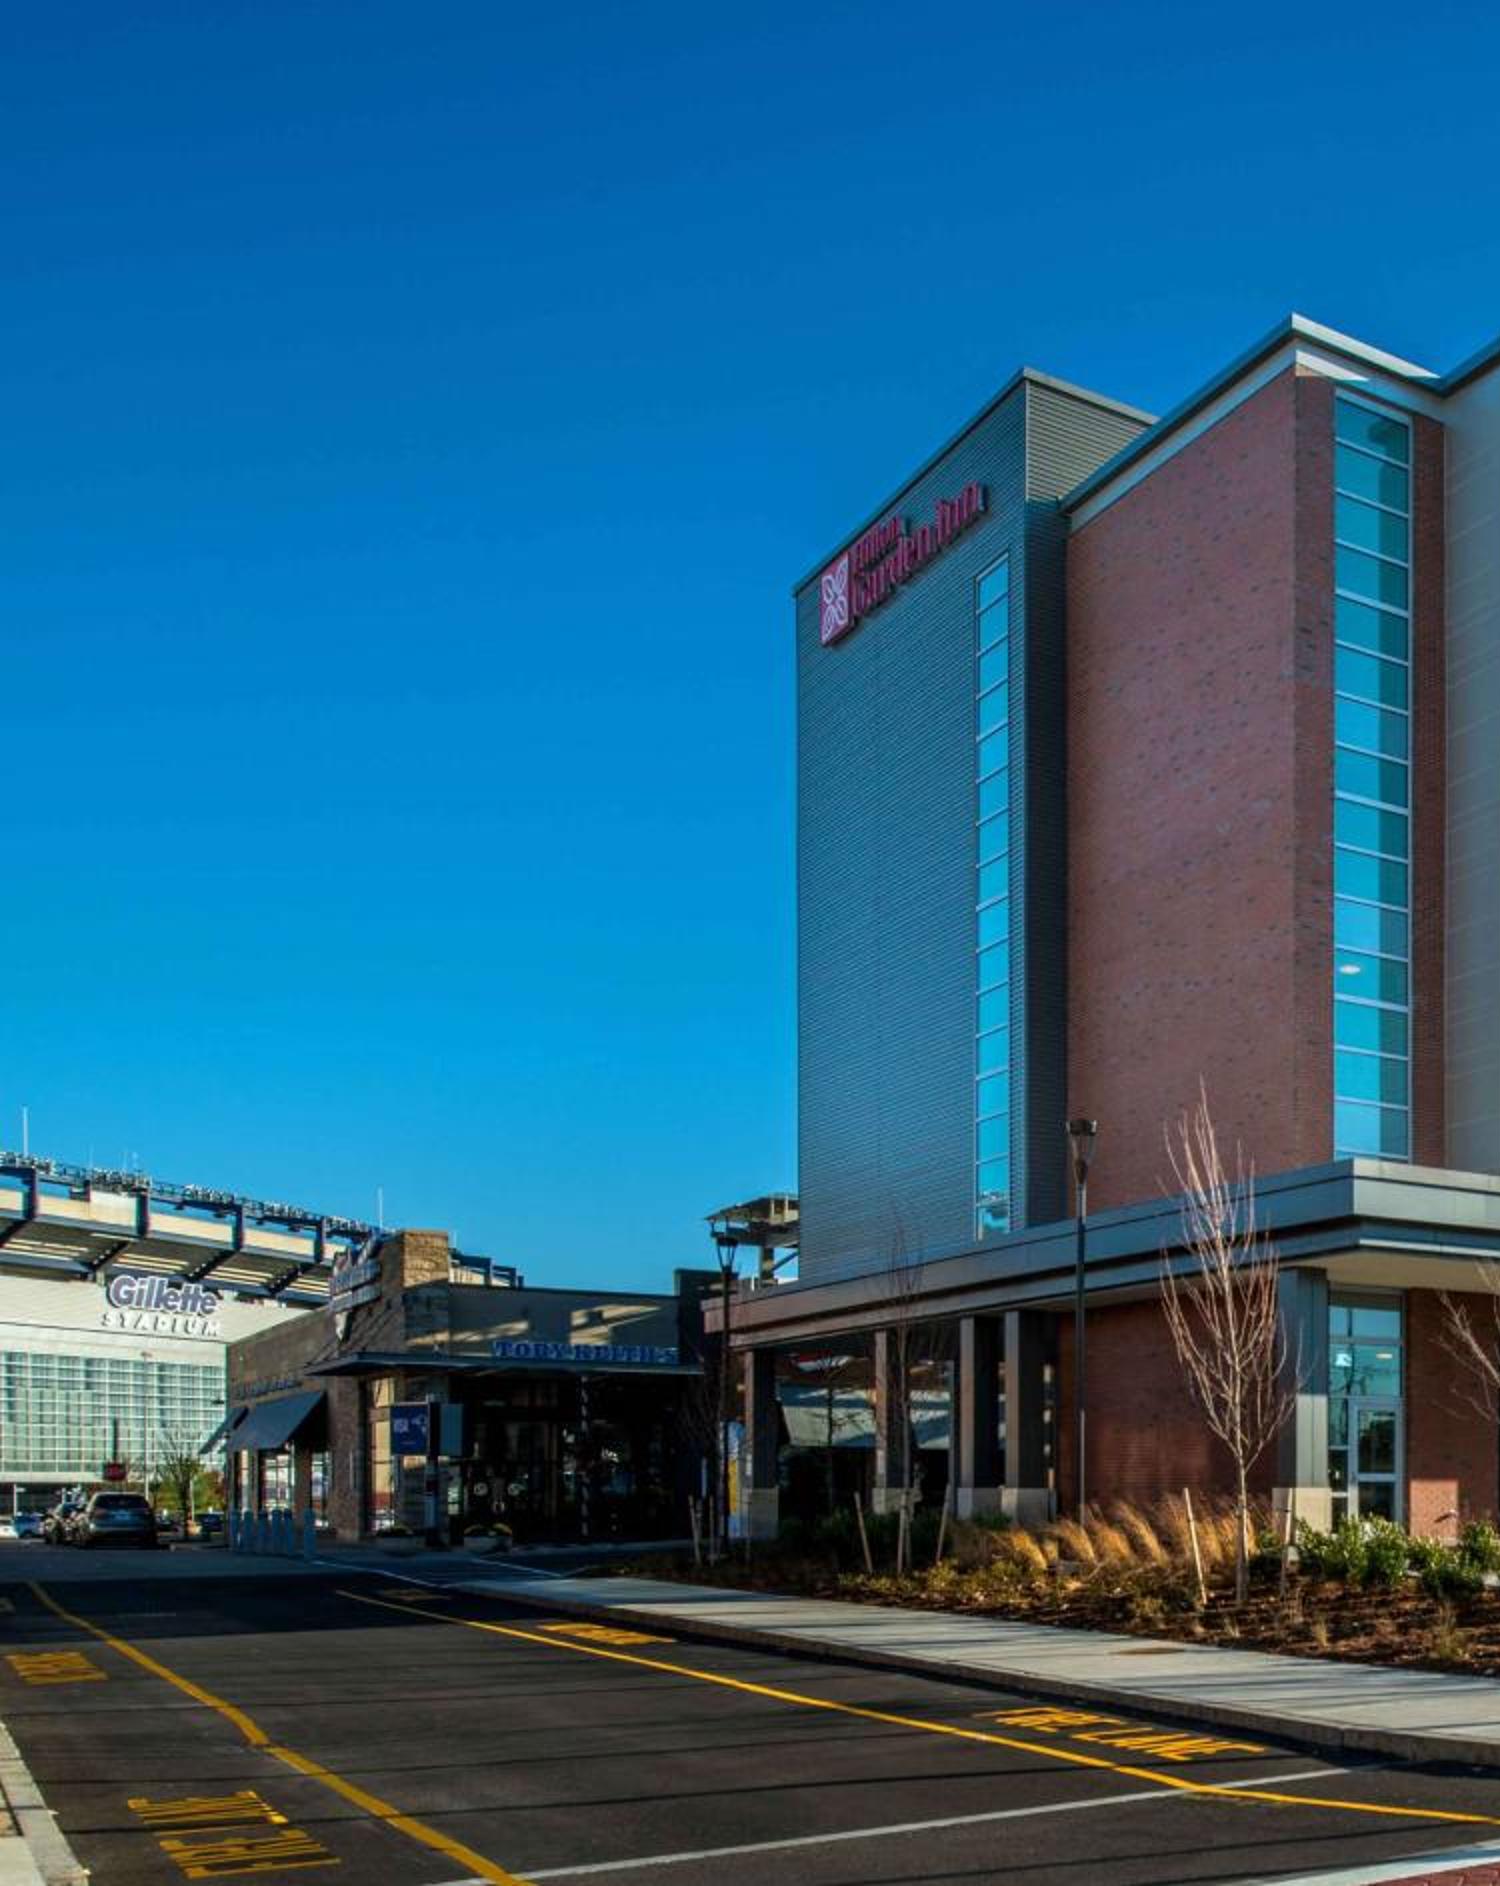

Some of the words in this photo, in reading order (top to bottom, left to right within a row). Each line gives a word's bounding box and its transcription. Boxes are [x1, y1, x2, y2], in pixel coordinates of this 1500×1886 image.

[851, 526, 932, 618] Garden
[935, 480, 986, 549] Inn
[110, 1274, 218, 1315] Gillette
[102, 1312, 221, 1337] STADIUM
